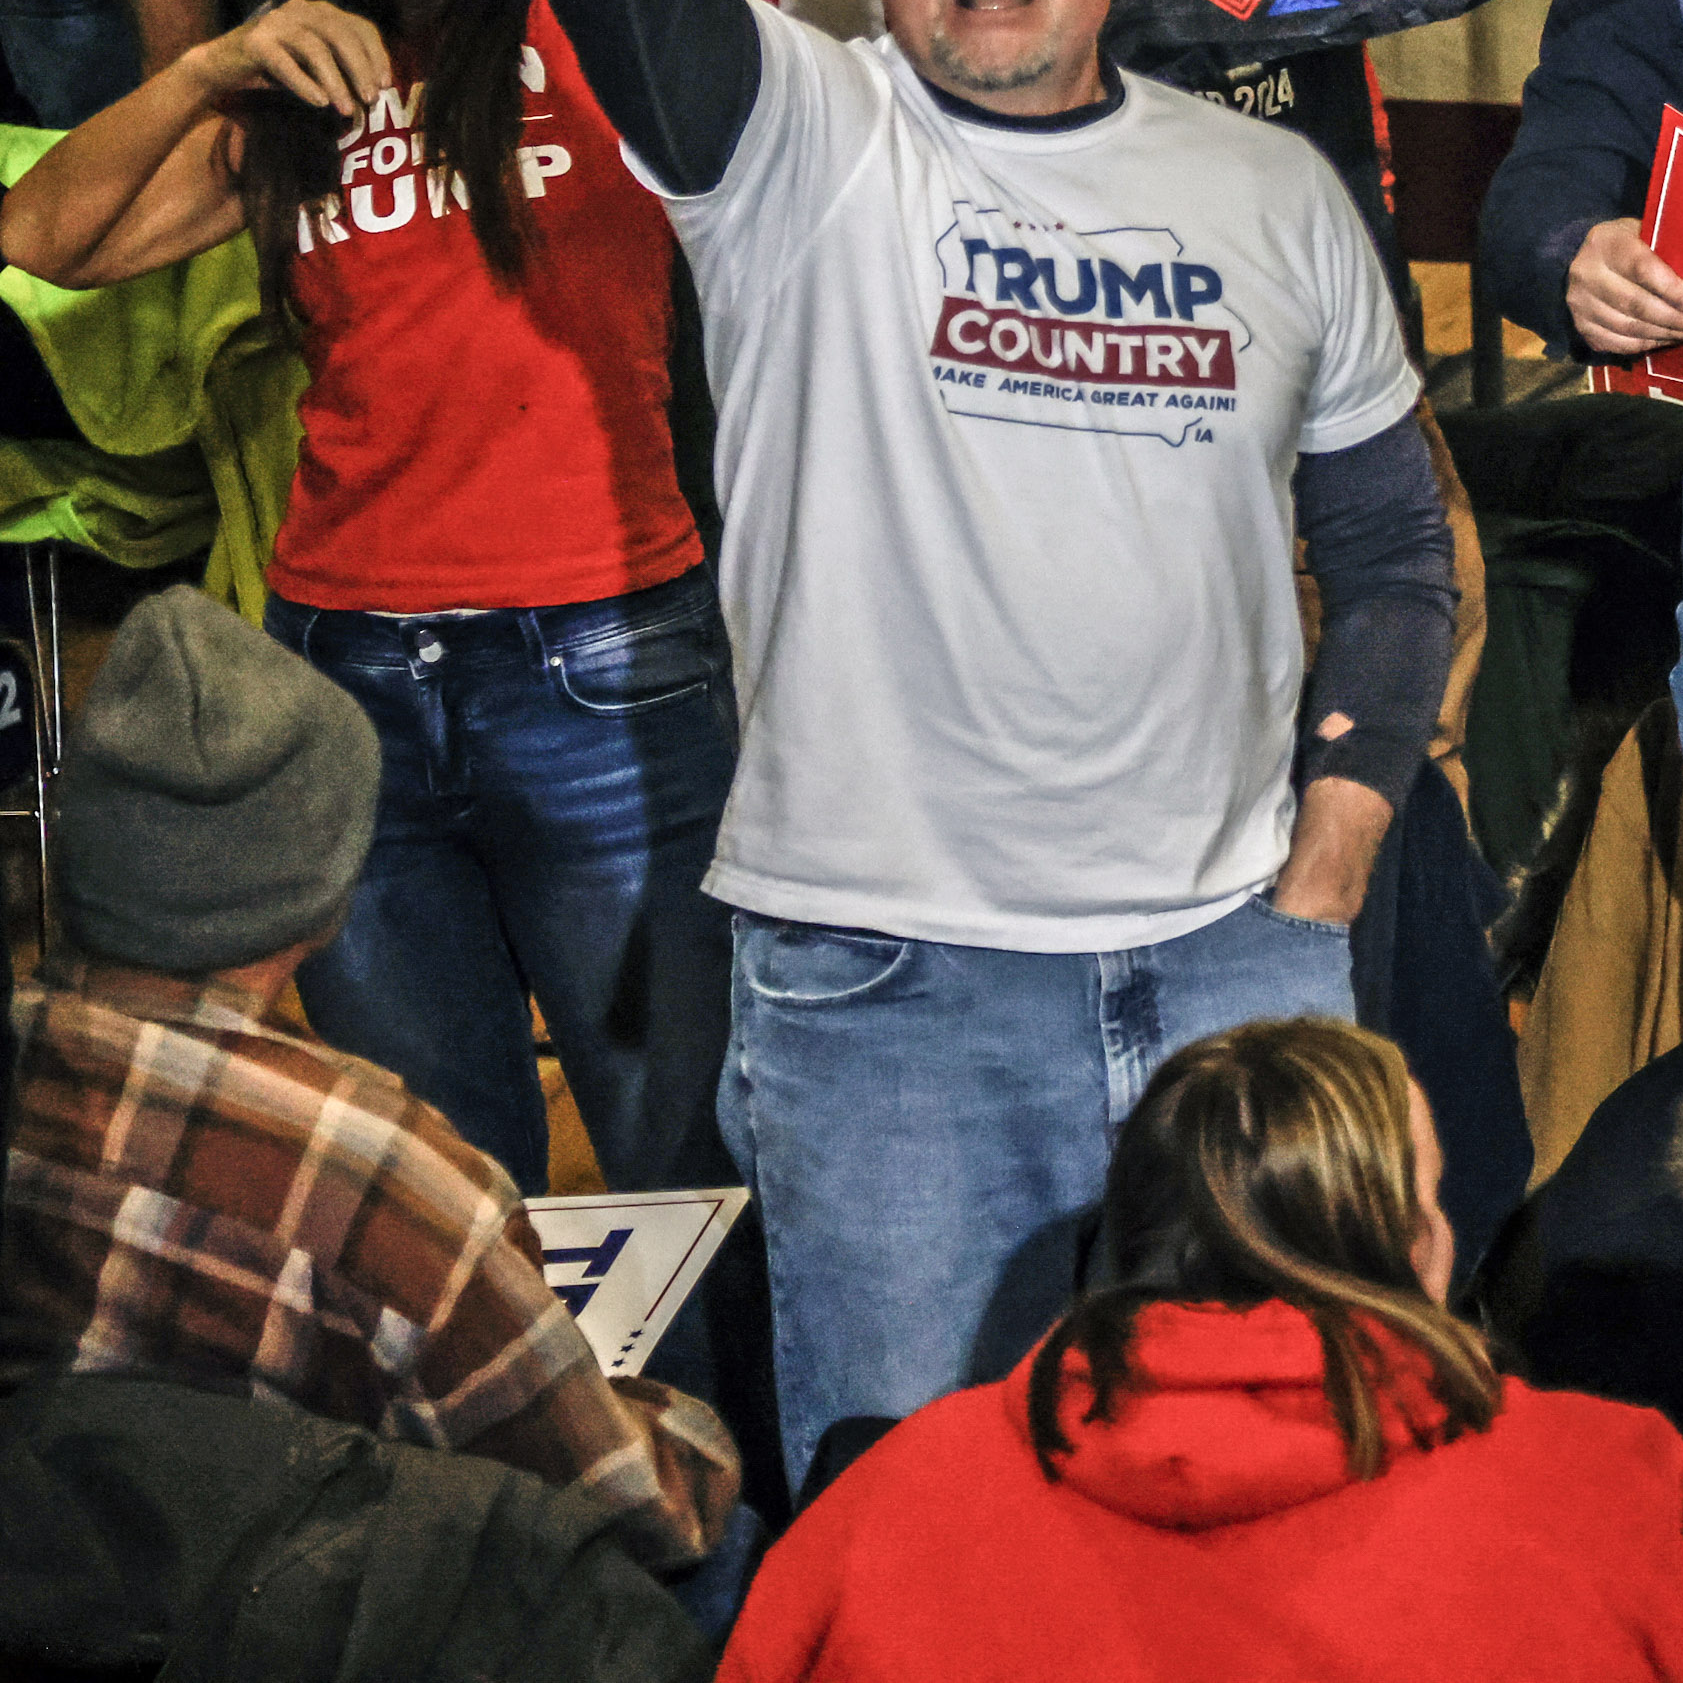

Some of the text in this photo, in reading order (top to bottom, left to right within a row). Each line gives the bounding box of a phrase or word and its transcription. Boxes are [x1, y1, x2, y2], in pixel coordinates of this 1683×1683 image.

[961, 238, 1223, 321] TRUMP
[947, 309, 1221, 378] COUNTRY
[998, 378, 1084, 403] AMERICA
[1090, 390, 1159, 408] GREAT
[1164, 393, 1236, 412] AGAIN!
[1195, 428, 1213, 444] IA
